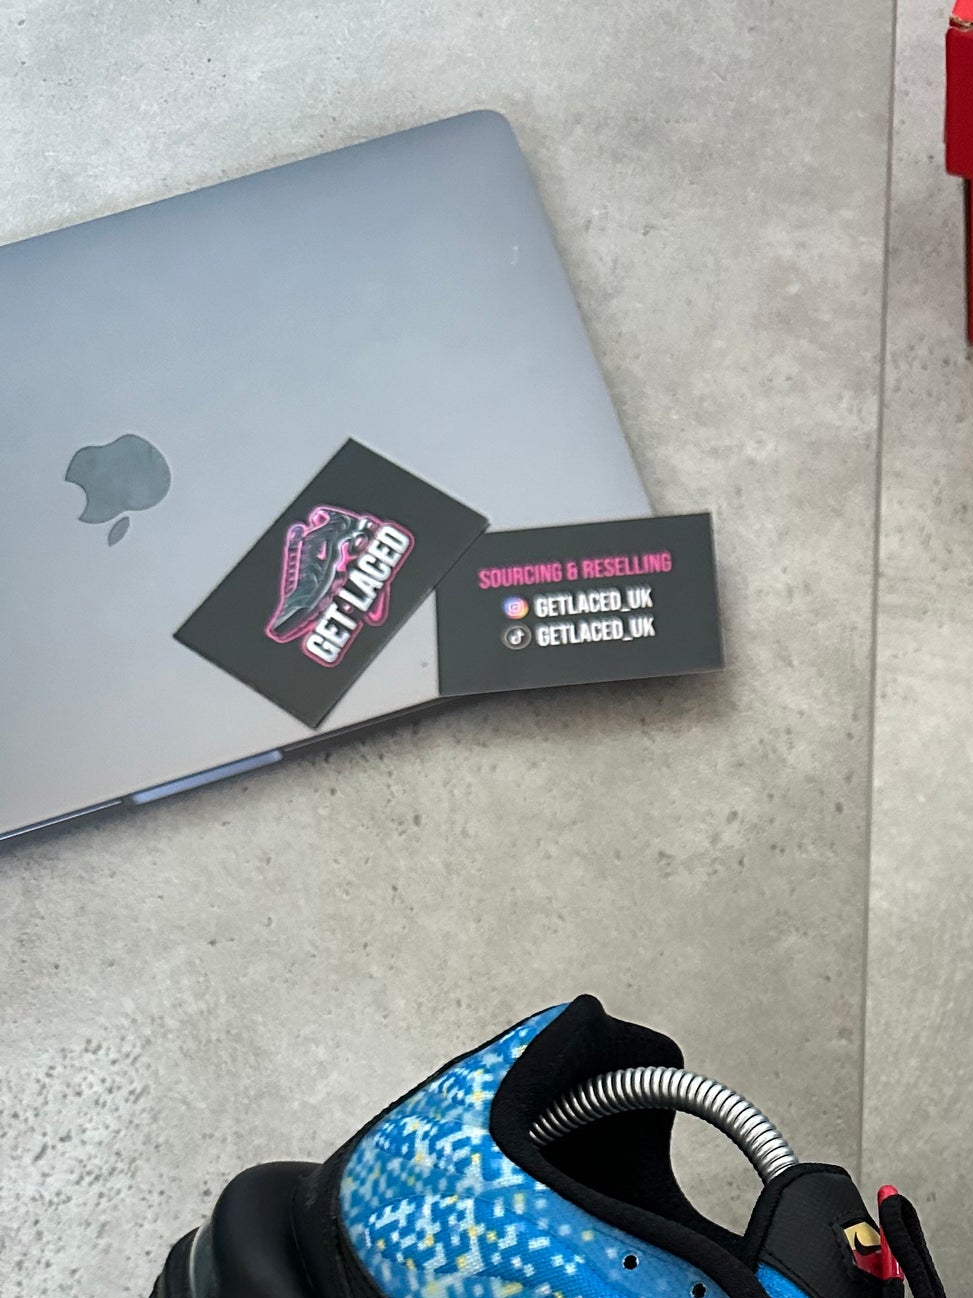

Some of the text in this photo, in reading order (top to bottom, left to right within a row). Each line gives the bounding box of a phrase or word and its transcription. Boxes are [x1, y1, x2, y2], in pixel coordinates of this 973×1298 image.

[478, 550, 673, 590] SOURCING & RESELLING
[306, 525, 410, 663] GET LACED
[533, 585, 654, 618] GETLACED_UK
[535, 615, 657, 647] GETLACED_UK
